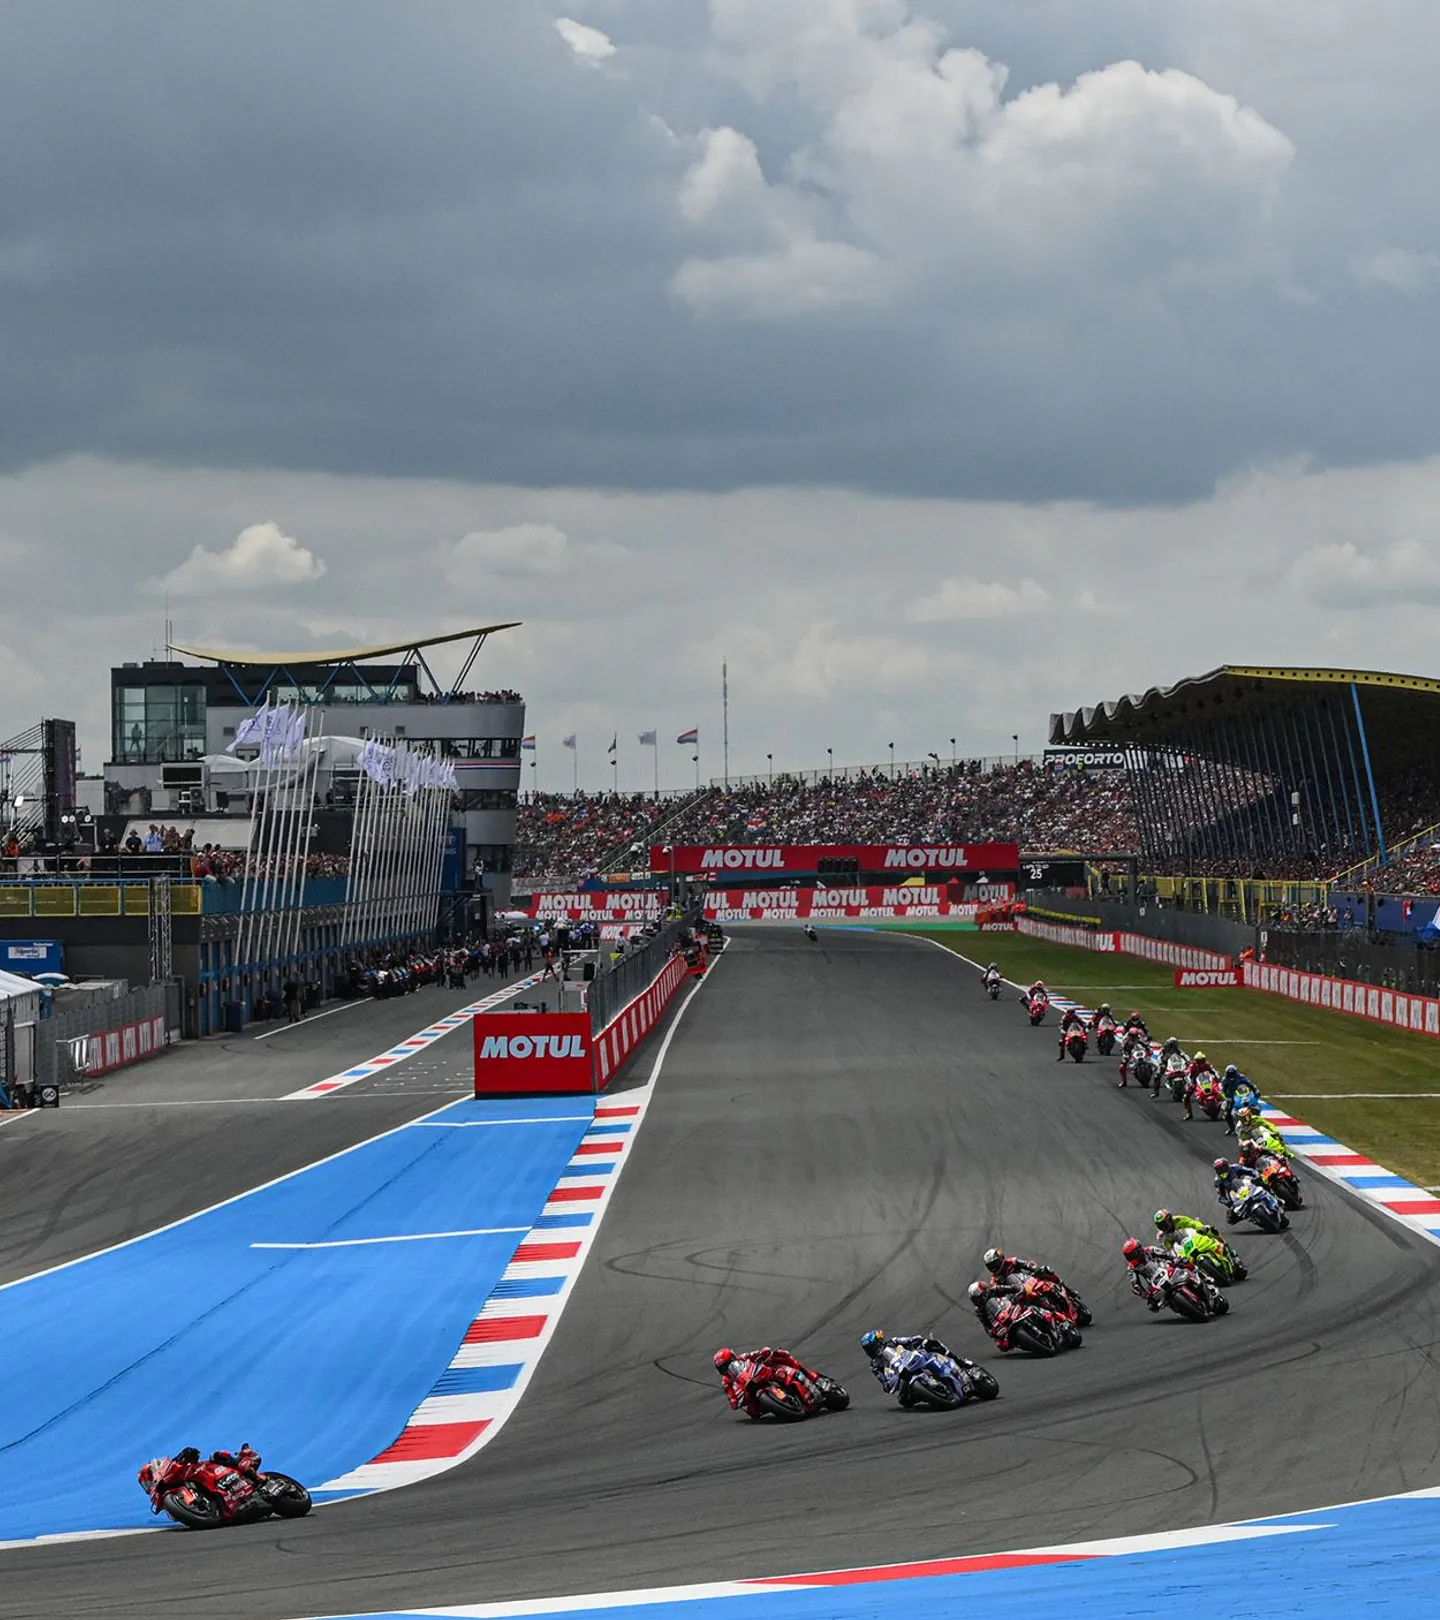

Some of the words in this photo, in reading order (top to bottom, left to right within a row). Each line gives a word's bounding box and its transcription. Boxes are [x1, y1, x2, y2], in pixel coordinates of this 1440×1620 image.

[701, 850, 785, 867] MOTUL
[885, 848, 967, 866] MOTUL
[1030, 868, 1042, 879] 25
[539, 894, 593, 910] MOTUL
[743, 889, 799, 908] MOTUL
[812, 889, 869, 907] MOTUL
[883, 887, 940, 905] MOTUL
[580, 911, 614, 920] MOTUL
[716, 909, 751, 920] MOTUL
[761, 908, 797, 919] MOTUL
[860, 907, 894, 917] MOTUL
[905, 905, 940, 916] MOTUL
[981, 923, 1014, 931] MOTUL
[1180, 971, 1237, 986] MOTUL
[480, 1035, 585, 1058] MOTUL
